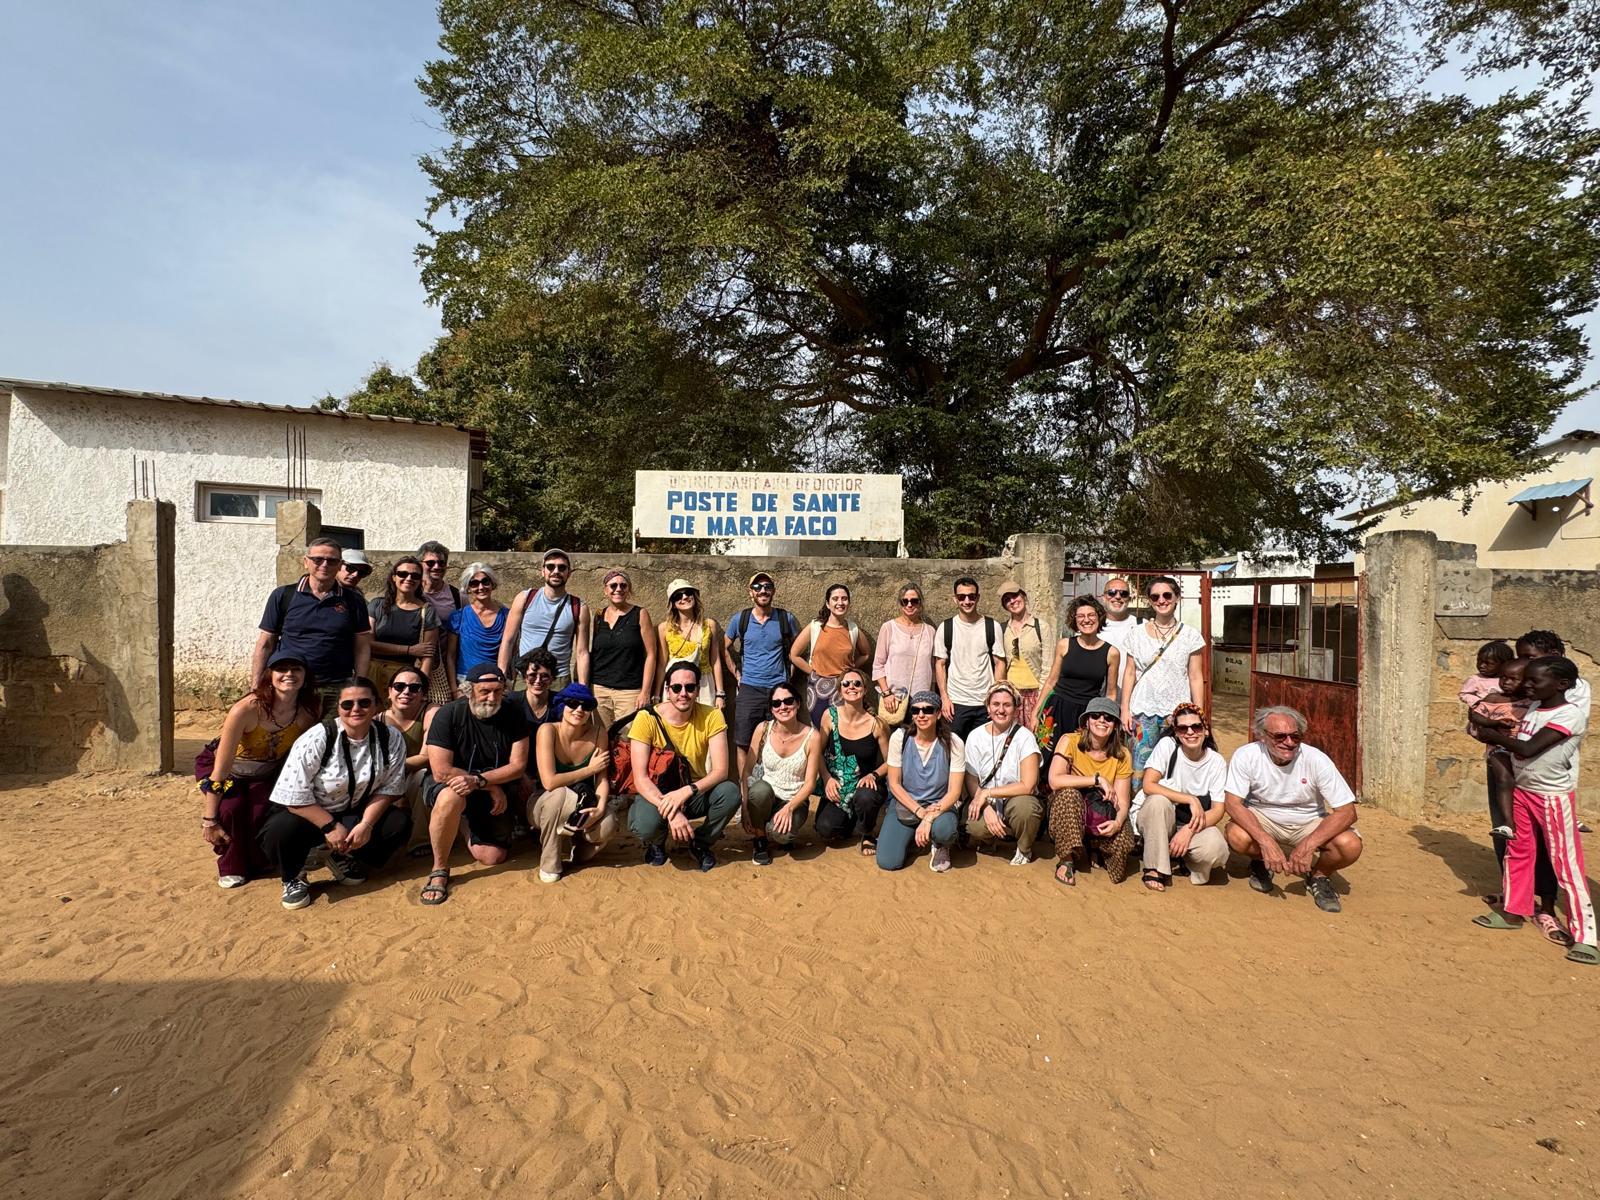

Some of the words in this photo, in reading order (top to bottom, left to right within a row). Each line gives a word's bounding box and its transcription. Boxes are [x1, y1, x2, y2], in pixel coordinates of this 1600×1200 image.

[813, 478, 863, 491] DIOFIOR
[667, 491, 738, 512] POSTE
[751, 493, 778, 512] DE
[793, 493, 861, 513] SANTE
[669, 515, 695, 535] DE
[784, 516, 837, 536] FACO
